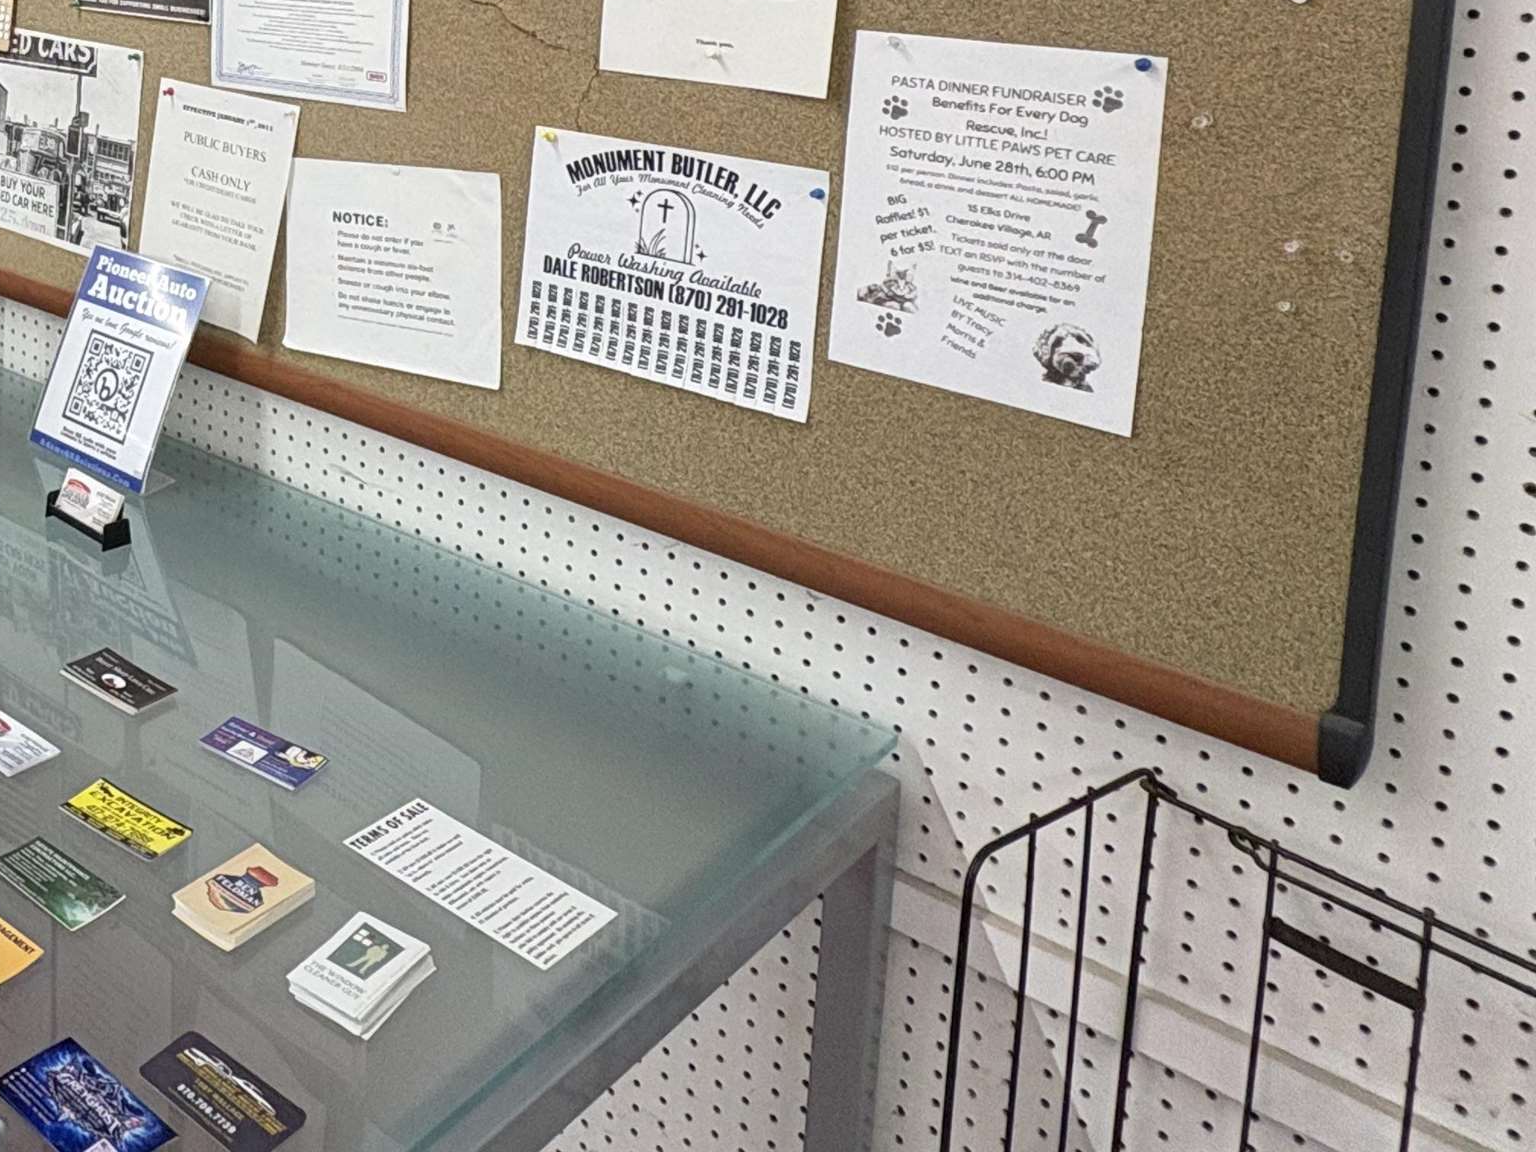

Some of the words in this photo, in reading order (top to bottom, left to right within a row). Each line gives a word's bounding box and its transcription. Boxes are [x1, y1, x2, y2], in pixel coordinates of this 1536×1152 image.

[37, 35, 92, 64] CARS
[891, 75, 935, 91] PASTA
[938, 80, 990, 98] DINNER
[992, 85, 1087, 107] FUNDRAISER
[184, 131, 220, 152] PUBLIC
[222, 141, 267, 163] BUYERS
[879, 125, 932, 143] HOSTED
[935, 130, 952, 143] BY
[955, 134, 999, 152] LITTLE
[1002, 140, 1041, 158] PAWS
[1044, 145, 1073, 160] PET
[1076, 149, 1116, 166] CARE
[191, 166, 219, 184] CASH
[221, 173, 251, 192] ONLY
[889, 146, 956, 167] Saturday,
[958, 154, 991, 171] June
[994, 158, 1032, 178] 28th,
[1035, 165, 1068, 181] 6:00
[1072, 169, 1095, 185] PM
[0, 175, 19, 190] BUY
[21, 181, 46, 200] YOUR
[566, 150, 665, 184] MONUMENT
[671, 153, 740, 198] BUTLER,
[743, 183, 782, 220] LLC
[12, 194, 29, 213] CAR
[31, 199, 54, 218] HERE
[332, 211, 388, 229] NOTICE:
[568, 243, 612, 267] Power
[618, 252, 683, 285] Washing
[689, 269, 762, 299] Available
[88, 276, 188, 328] Auction
[161, 276, 197, 302] Auto
[543, 255, 578, 280] DALE
[582, 264, 664, 299] ROBERTSON
[669, 288, 712, 311] (870)
[716, 295, 789, 330] 291-1028
[90, 790, 177, 841] EXCAVATION
[350, 822, 387, 852] TERMS
[385, 817, 403, 833] OF
[400, 802, 429, 823] SALE
[234, 879, 256, 895] BEN
